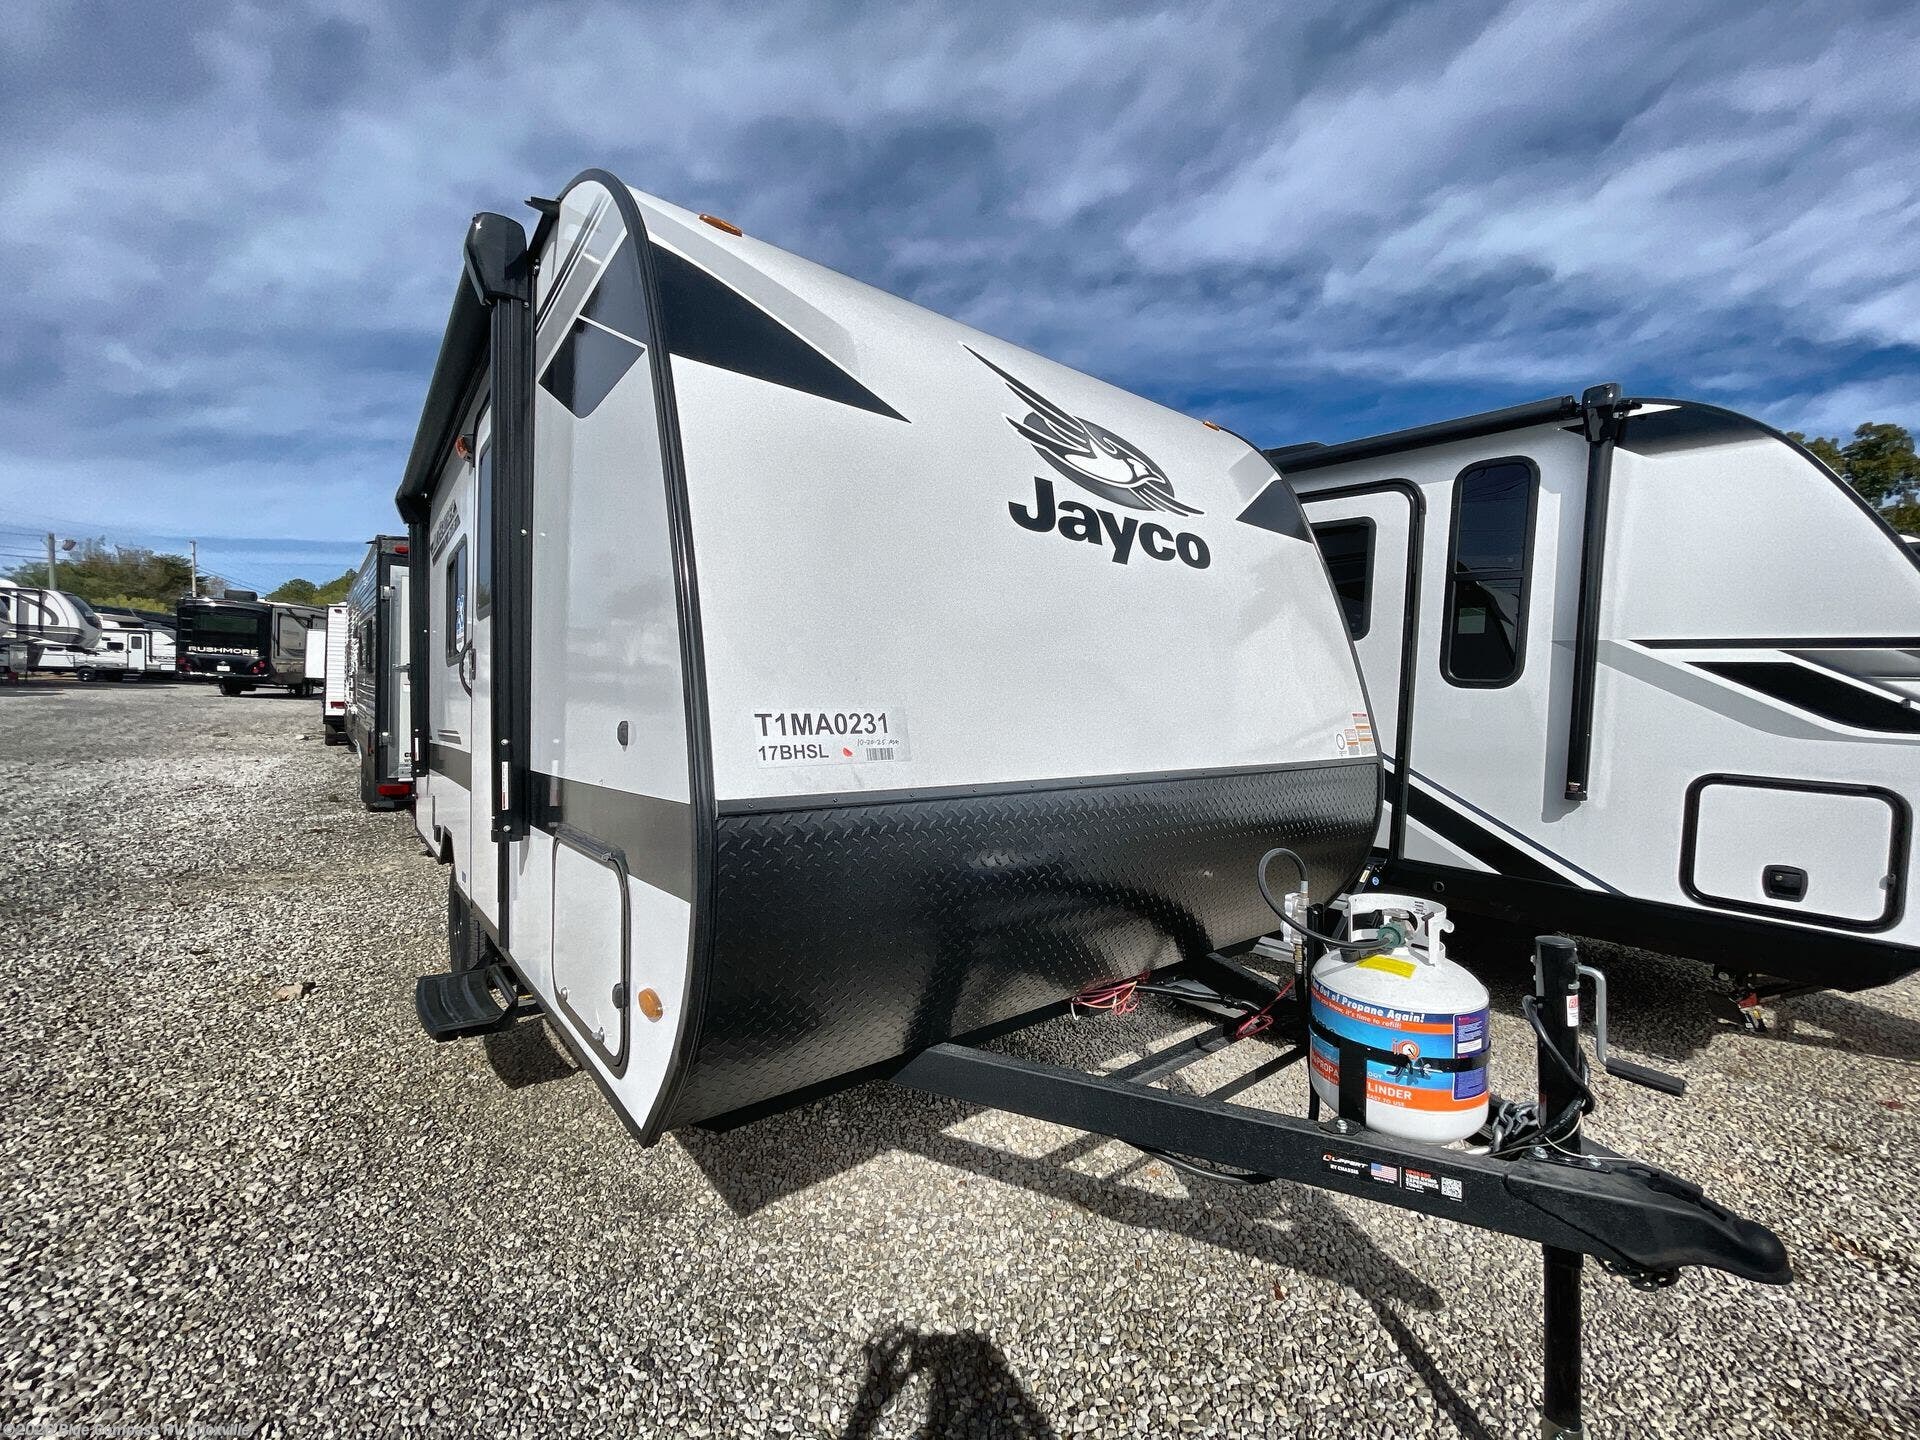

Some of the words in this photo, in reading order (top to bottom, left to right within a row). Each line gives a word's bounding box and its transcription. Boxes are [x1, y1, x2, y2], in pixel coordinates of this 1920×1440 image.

[1008, 476, 1211, 569] Jayco
[188, 645, 259, 657] RUSHMORE
[754, 712, 889, 736] T1MA0231
[758, 743, 830, 761] 17BHSL
[1341, 996, 1384, 1017] Propane
[1386, 1009, 1426, 1023] Again!
[1367, 1082, 1413, 1100] LINDER
